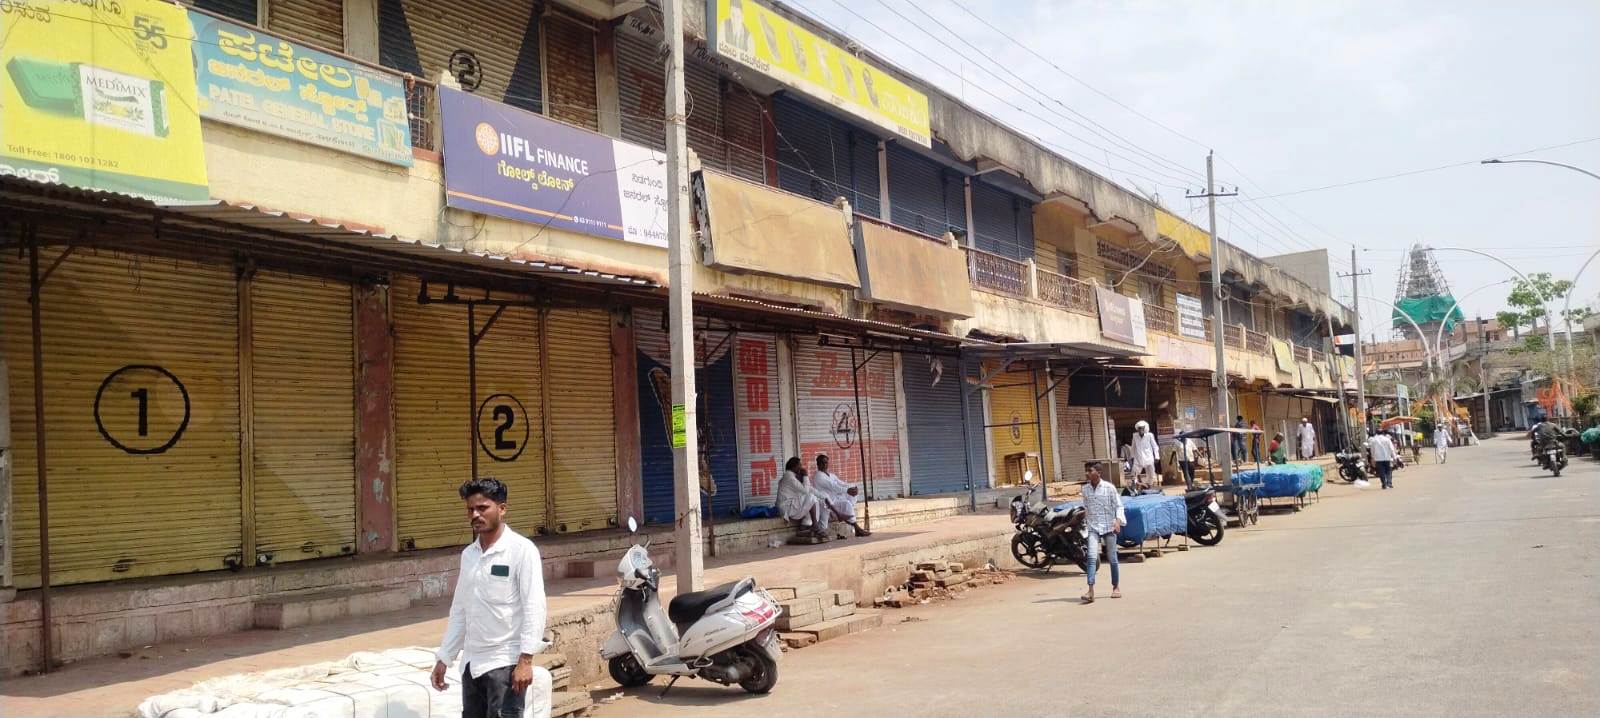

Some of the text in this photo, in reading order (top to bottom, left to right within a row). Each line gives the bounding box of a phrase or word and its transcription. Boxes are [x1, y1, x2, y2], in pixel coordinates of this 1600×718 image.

[134, 15, 168, 50] 55
[86, 74, 147, 98] MEDIMIX
[459, 56, 475, 86] 2
[208, 83, 257, 108] PATEL
[262, 100, 329, 129] GENERAL
[7, 144, 25, 154] Toll
[54, 151, 76, 163] 1800
[500, 132, 589, 176] IIFL FINANCE
[131, 388, 149, 436] 1
[492, 405, 517, 449] 2
[836, 411, 851, 444] 4
